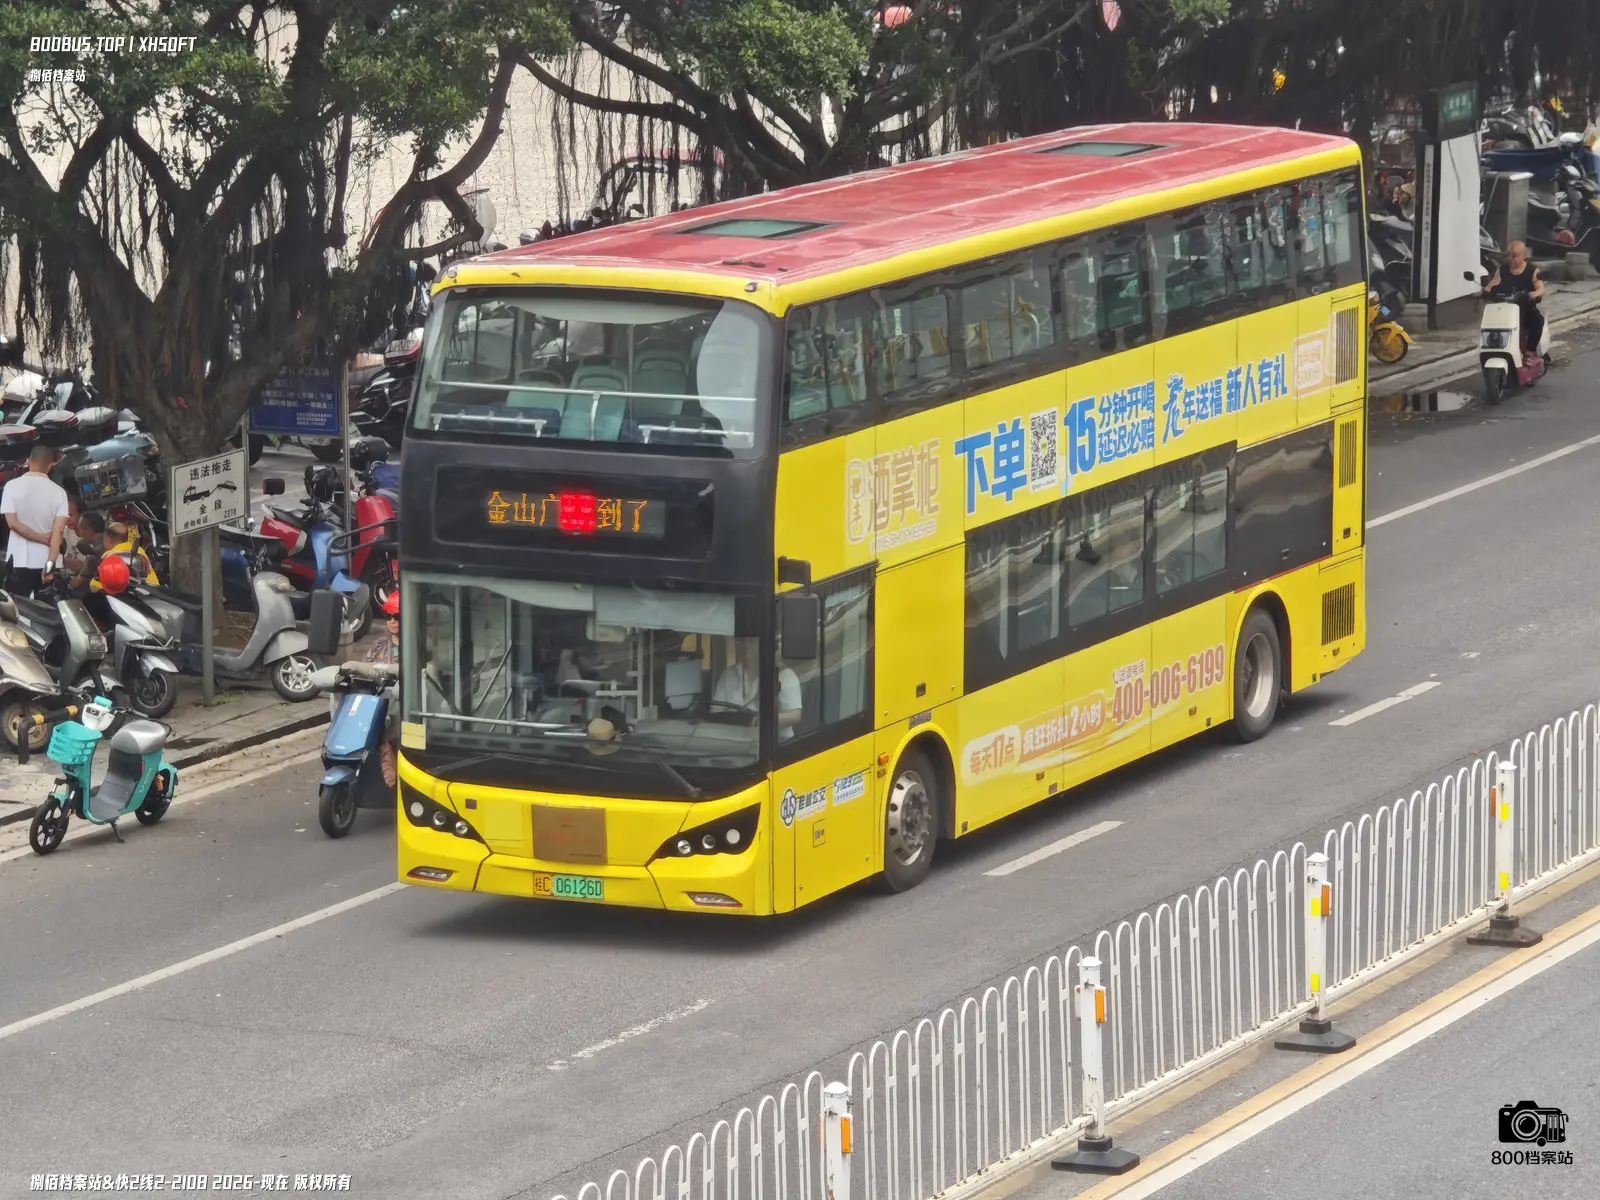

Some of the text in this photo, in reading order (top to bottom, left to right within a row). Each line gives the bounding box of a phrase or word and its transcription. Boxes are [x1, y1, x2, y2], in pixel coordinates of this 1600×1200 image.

[1225, 352, 1288, 414] 新人有礼
[189, 458, 232, 481] 违法拖走
[954, 417, 1028, 515] 下单
[1063, 396, 1097, 475] 15
[487, 490, 648, 532] 金山广到了
[1111, 644, 1226, 726] 400-006-6199
